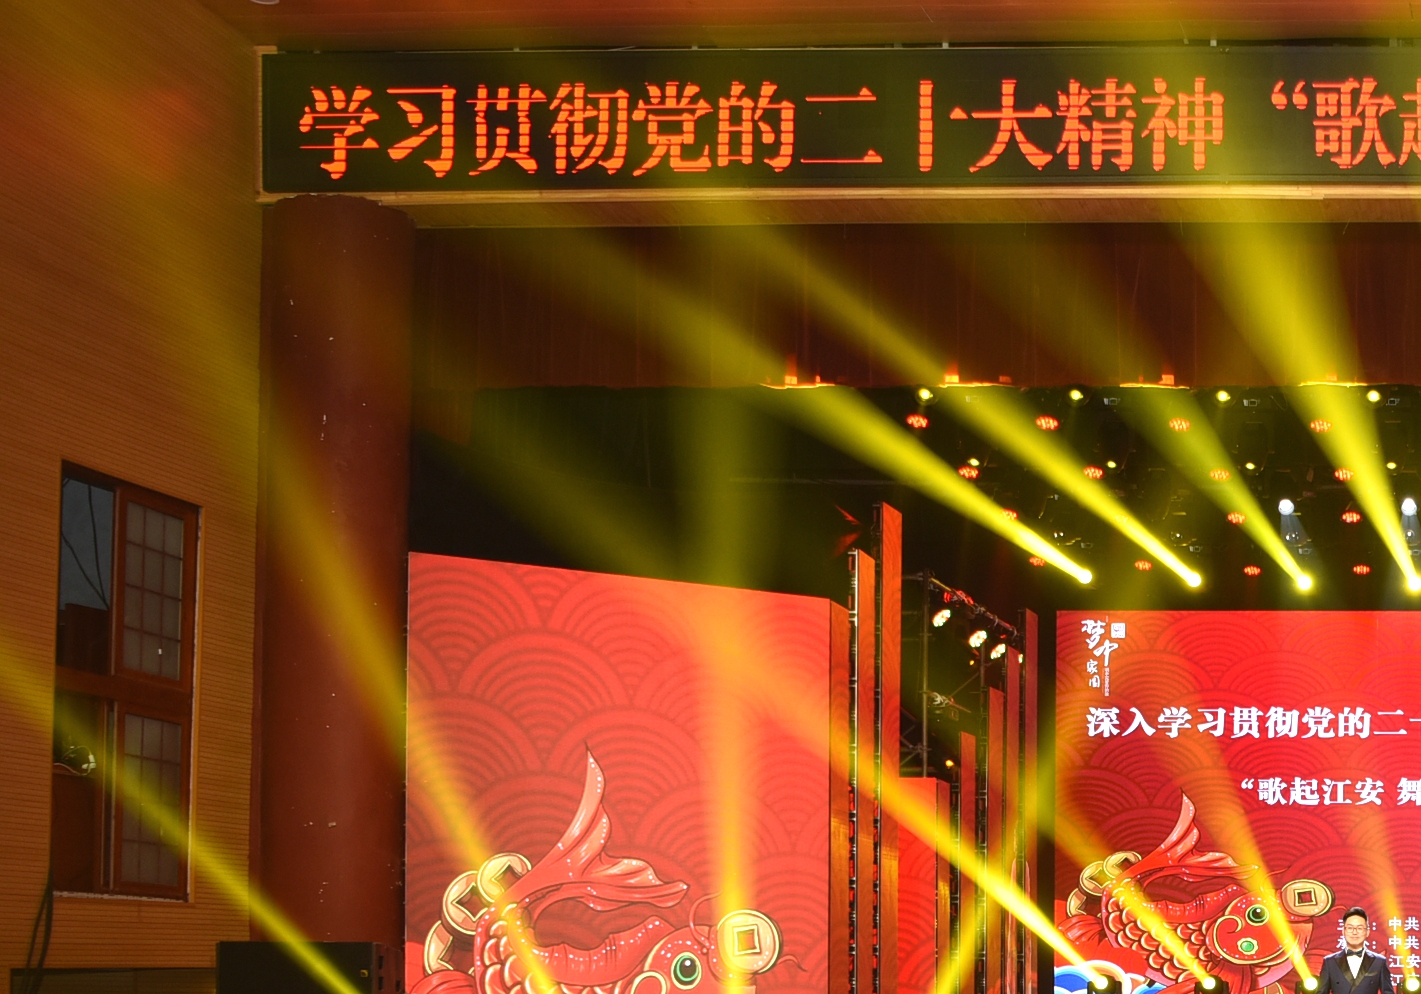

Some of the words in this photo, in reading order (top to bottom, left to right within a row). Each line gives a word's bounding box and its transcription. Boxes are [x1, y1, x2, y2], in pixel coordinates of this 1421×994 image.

[300, 78, 1225, 179] 学习贯彻党的二十大精神
[1240, 776, 1385, 807] “歌起江安
